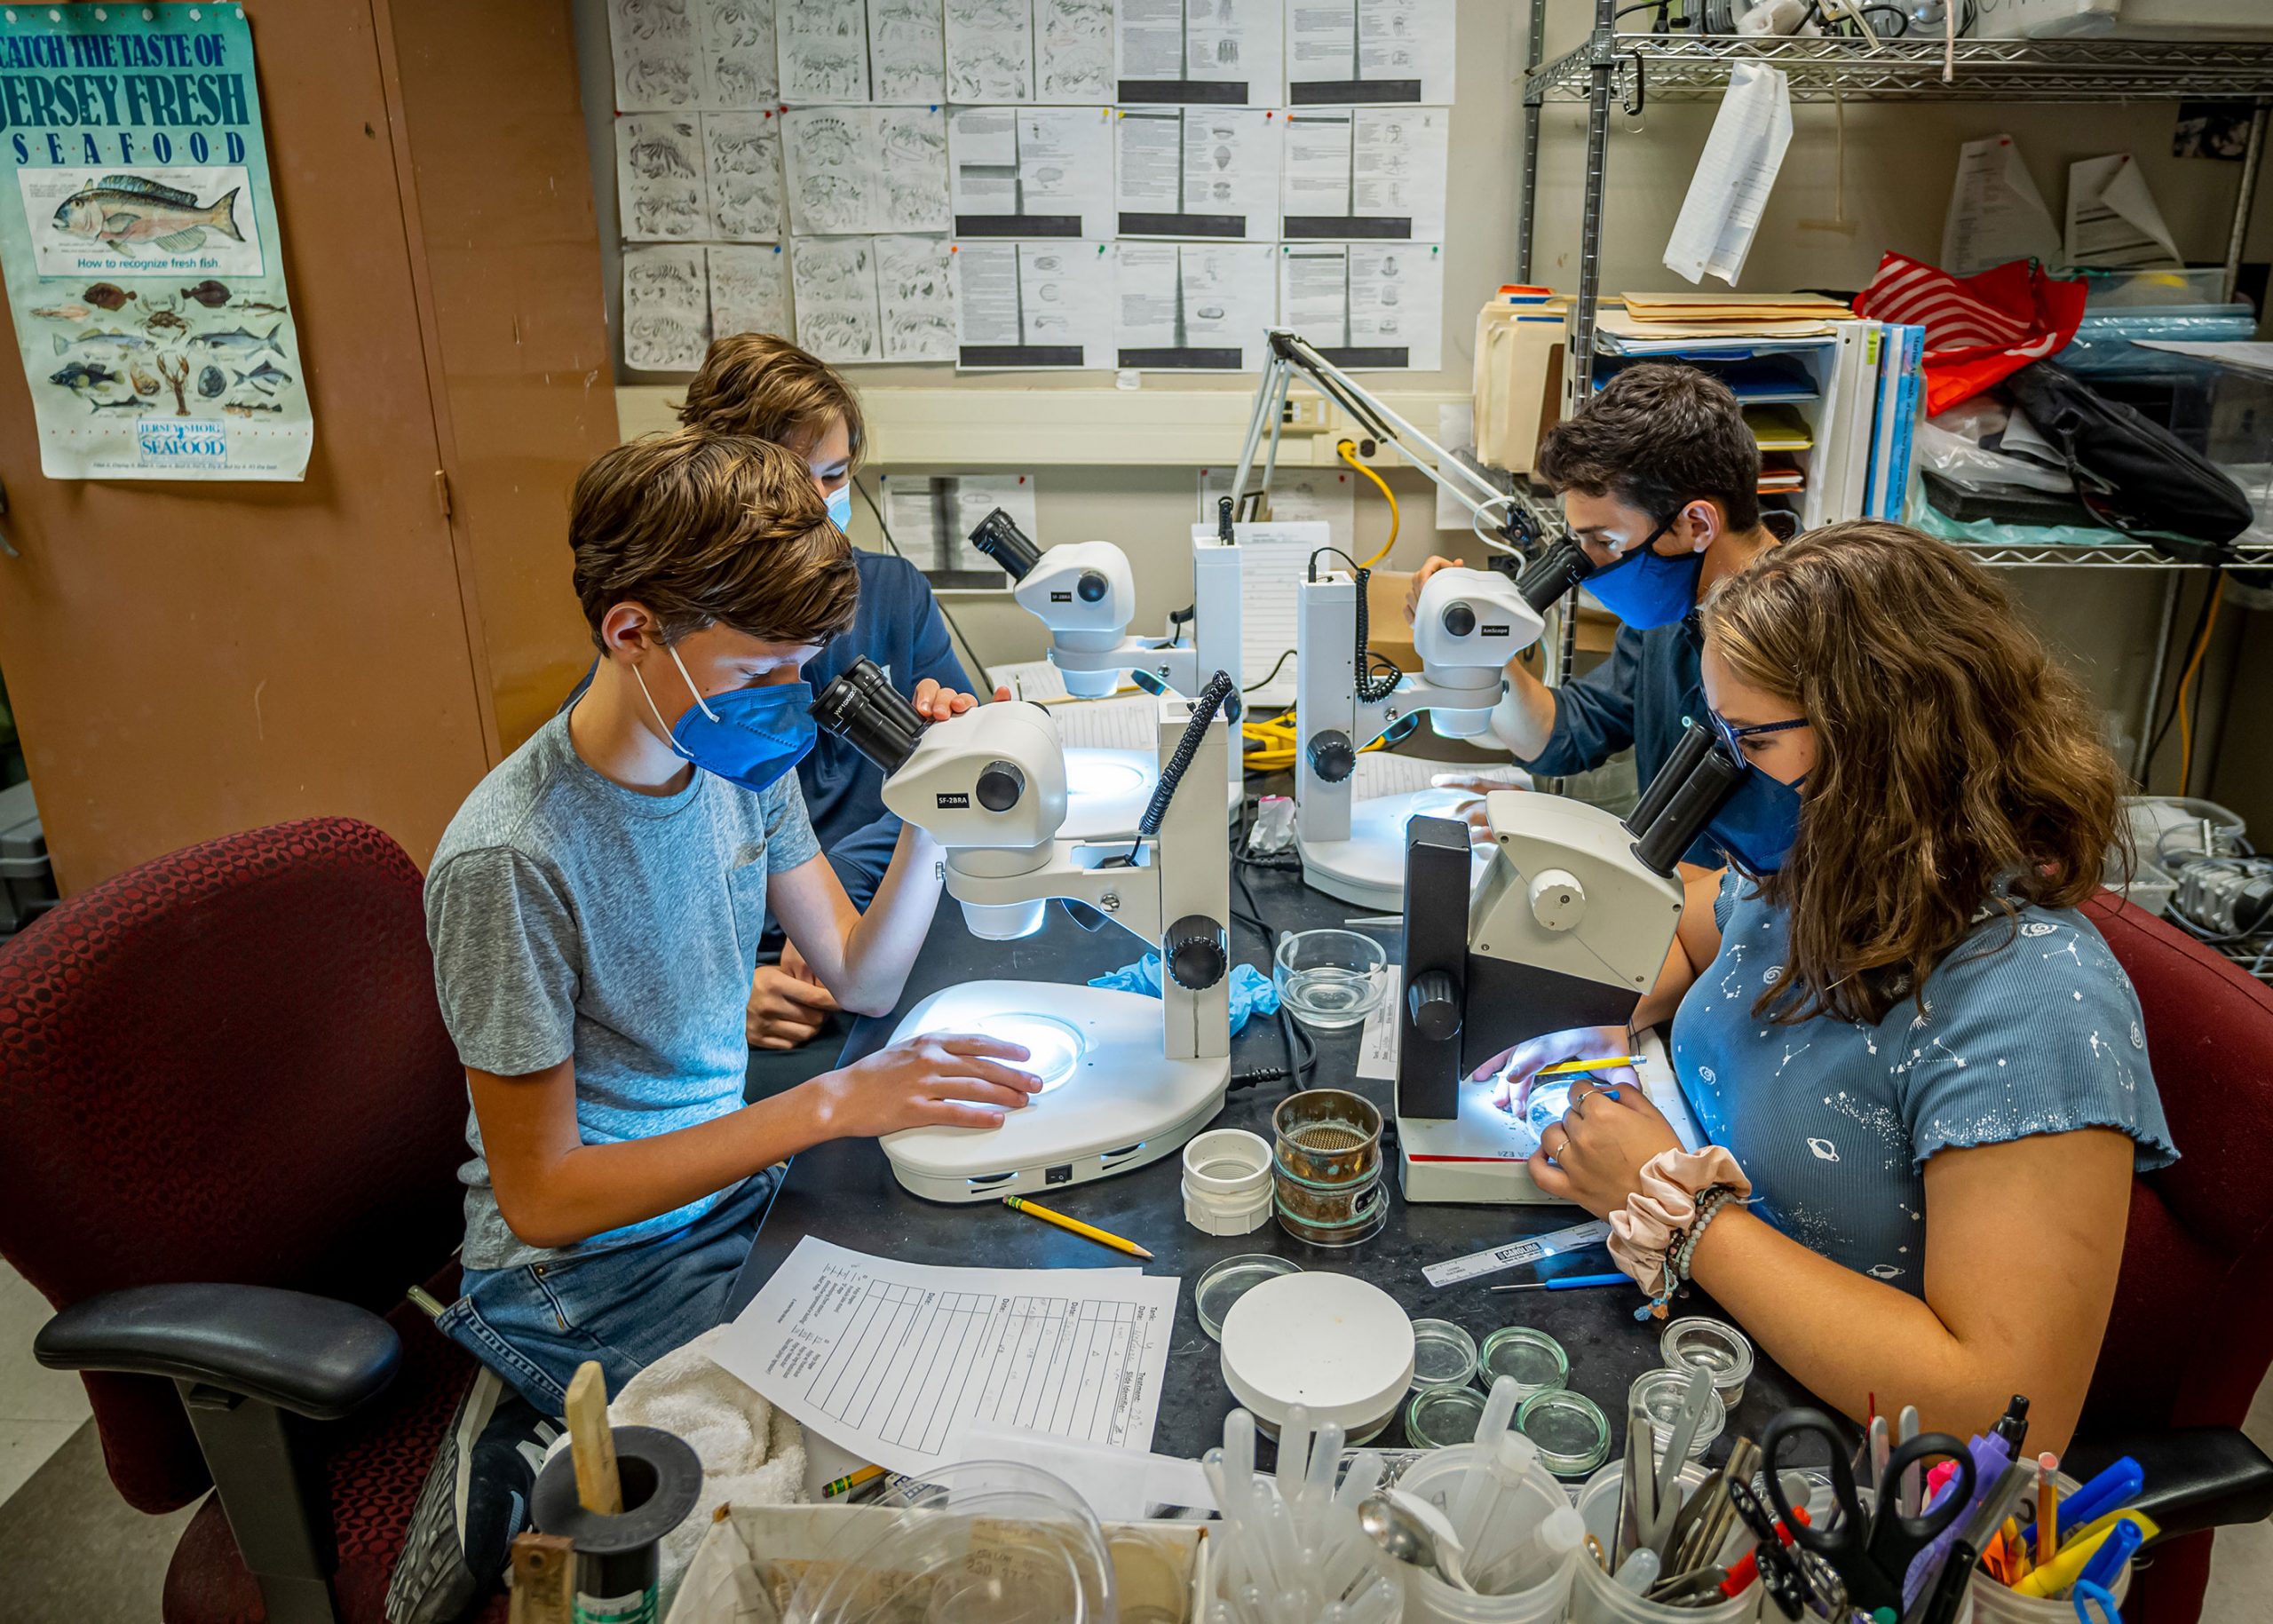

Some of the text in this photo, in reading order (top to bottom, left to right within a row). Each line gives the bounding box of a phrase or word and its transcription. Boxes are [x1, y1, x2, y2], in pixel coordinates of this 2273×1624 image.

[67, 34, 117, 68] THE
[116, 34, 193, 68] TASTE
[194, 33, 226, 67] OF
[123, 73, 250, 127] FRESH
[77, 258, 104, 268] How
[106, 259, 116, 268] to
[119, 258, 169, 271] recognize
[170, 258, 196, 268] fresh
[142, 440, 225, 456] SEAFOOD
[1502, 1243, 1540, 1259] CAROLINA
[924, 1292, 936, 1306] Date:
[999, 1298, 1010, 1314] Date:
[1068, 1302, 1079, 1318] Date:
[1136, 1305, 1146, 1321] Date:
[1124, 1371, 1134, 1385] Slide
[1133, 1372, 1146, 1403] Treatment:
